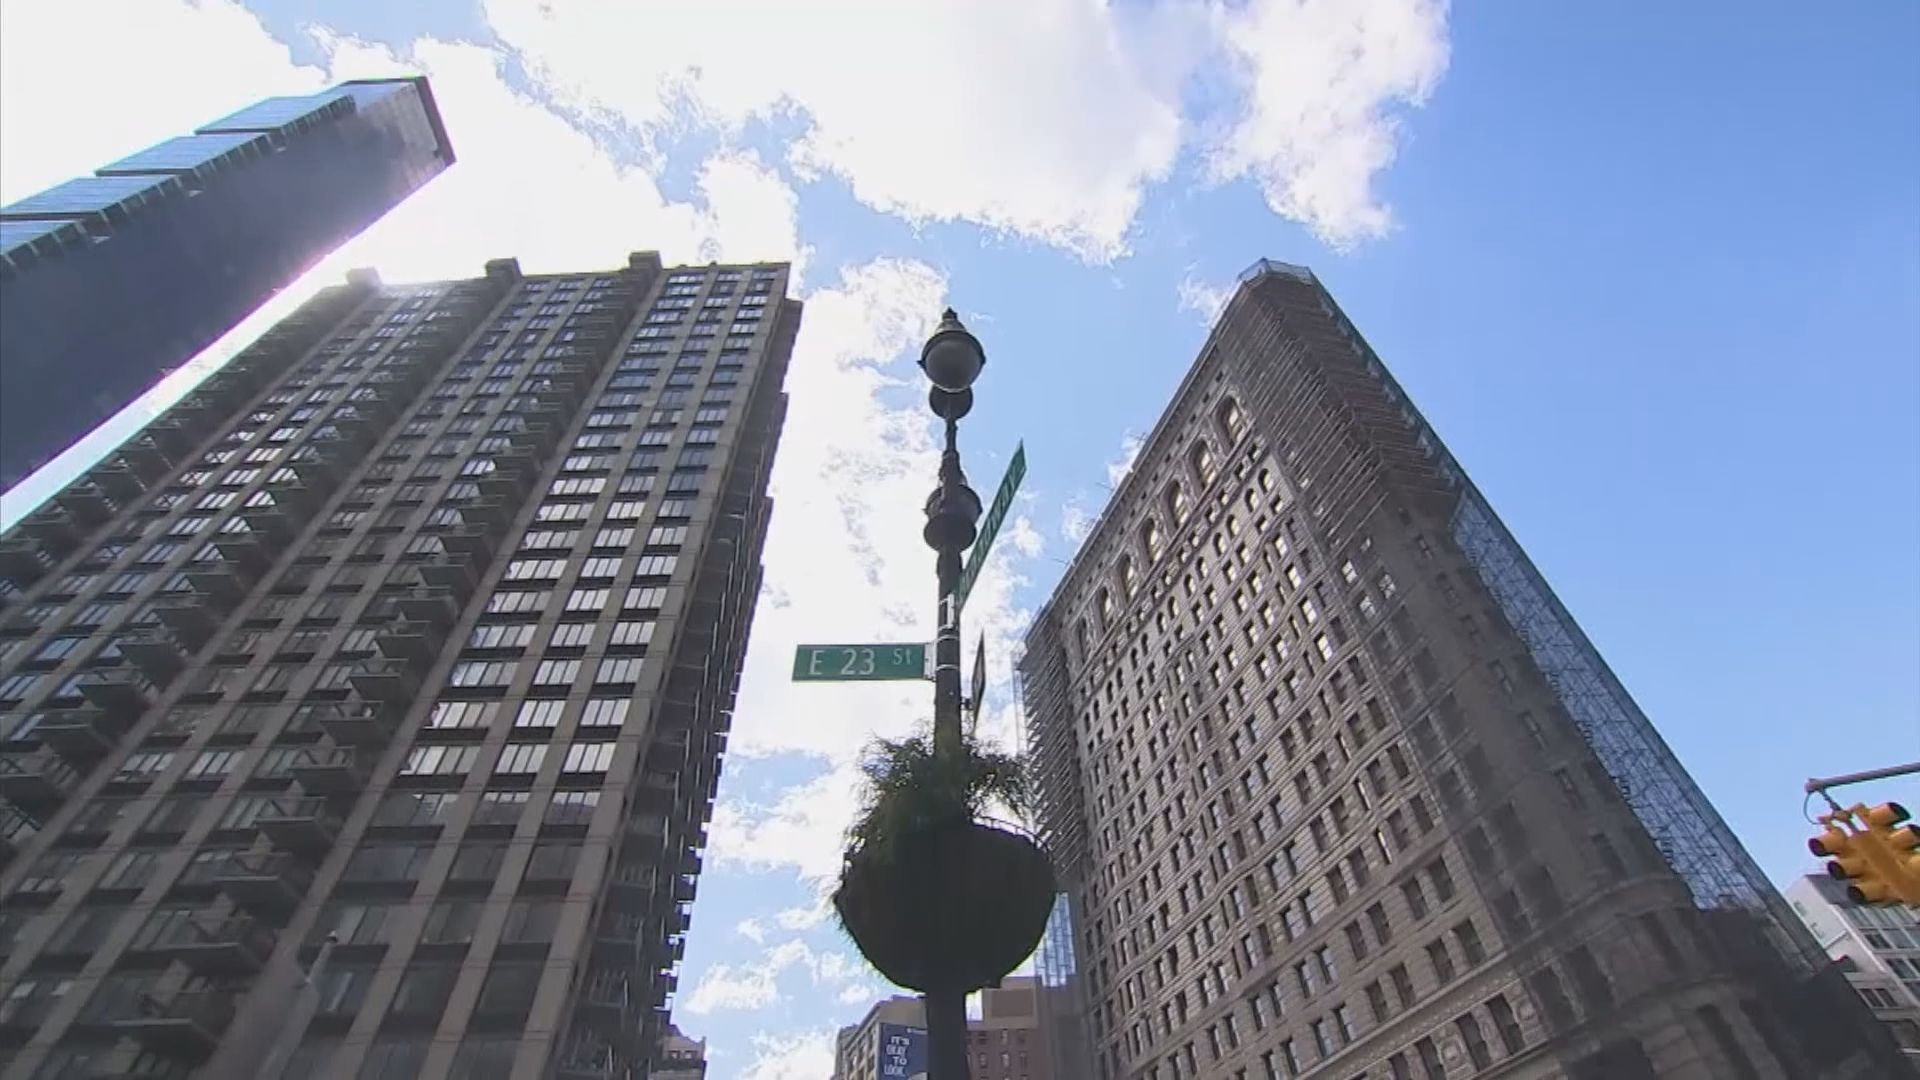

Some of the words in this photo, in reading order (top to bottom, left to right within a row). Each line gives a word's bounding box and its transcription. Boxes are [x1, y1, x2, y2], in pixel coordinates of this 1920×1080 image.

[808, 649, 825, 675] E
[840, 648, 875, 676] 23
[892, 1056, 907, 1065] TO
